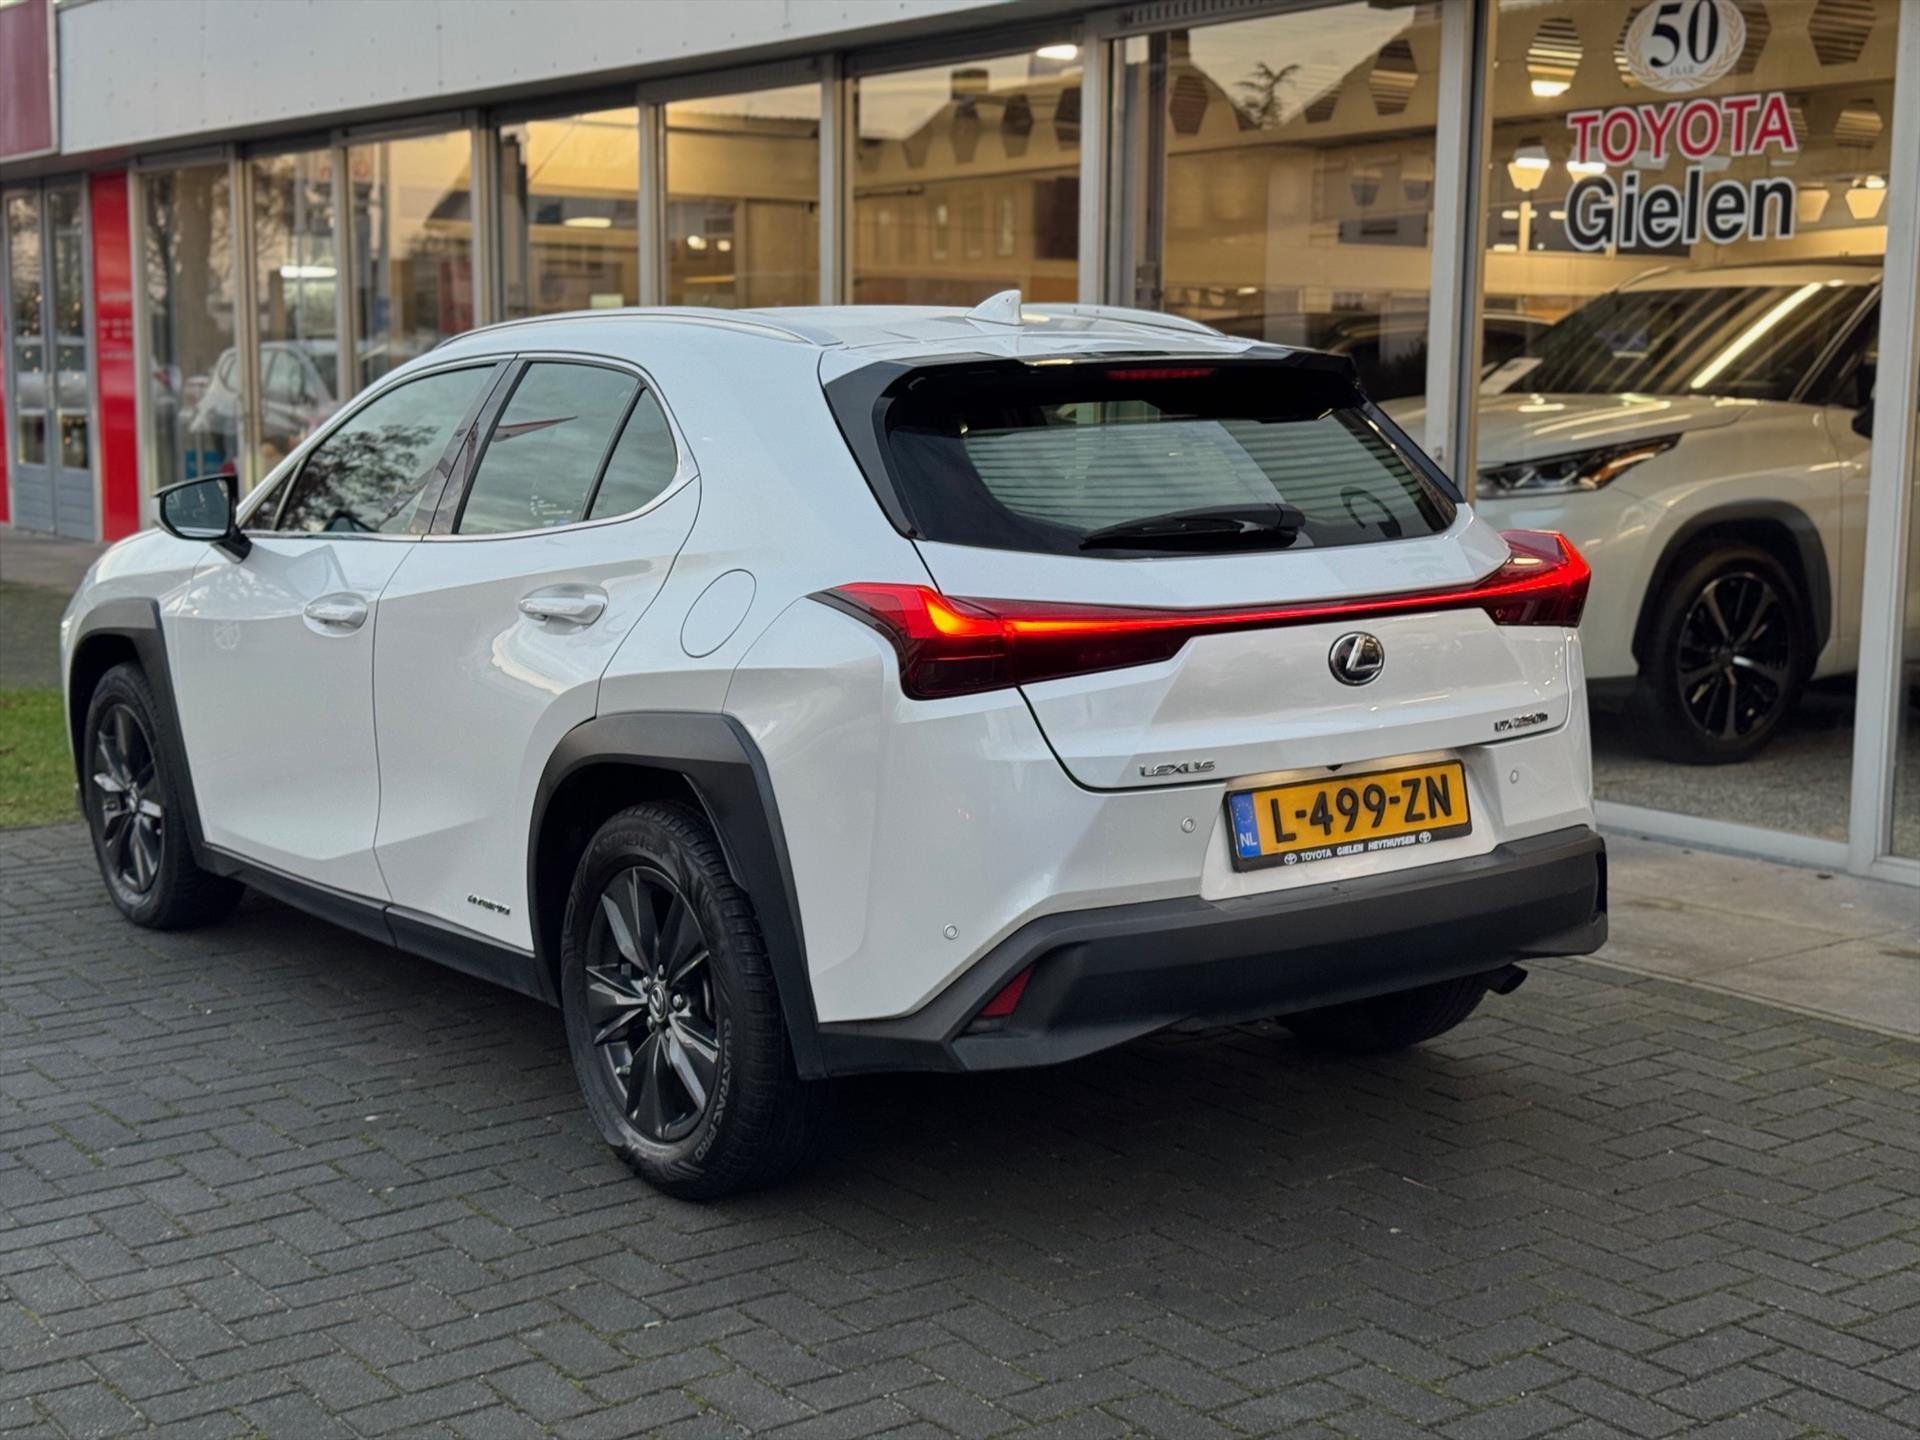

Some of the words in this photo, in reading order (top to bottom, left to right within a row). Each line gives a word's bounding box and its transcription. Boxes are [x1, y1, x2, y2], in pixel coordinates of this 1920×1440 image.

[1650, 0, 1719, 68] 50
[1567, 92, 1798, 166] TOYOTA
[1565, 166, 1796, 250] Gielen
[1139, 760, 1216, 777] LEXUS
[1240, 832, 1258, 848] NL
[1269, 773, 1453, 844] L-499-ZN
[1300, 848, 1333, 862] TOYOTA
[1336, 843, 1364, 856] GIELEN
[1368, 834, 1416, 851] HEYTHUYSEN
